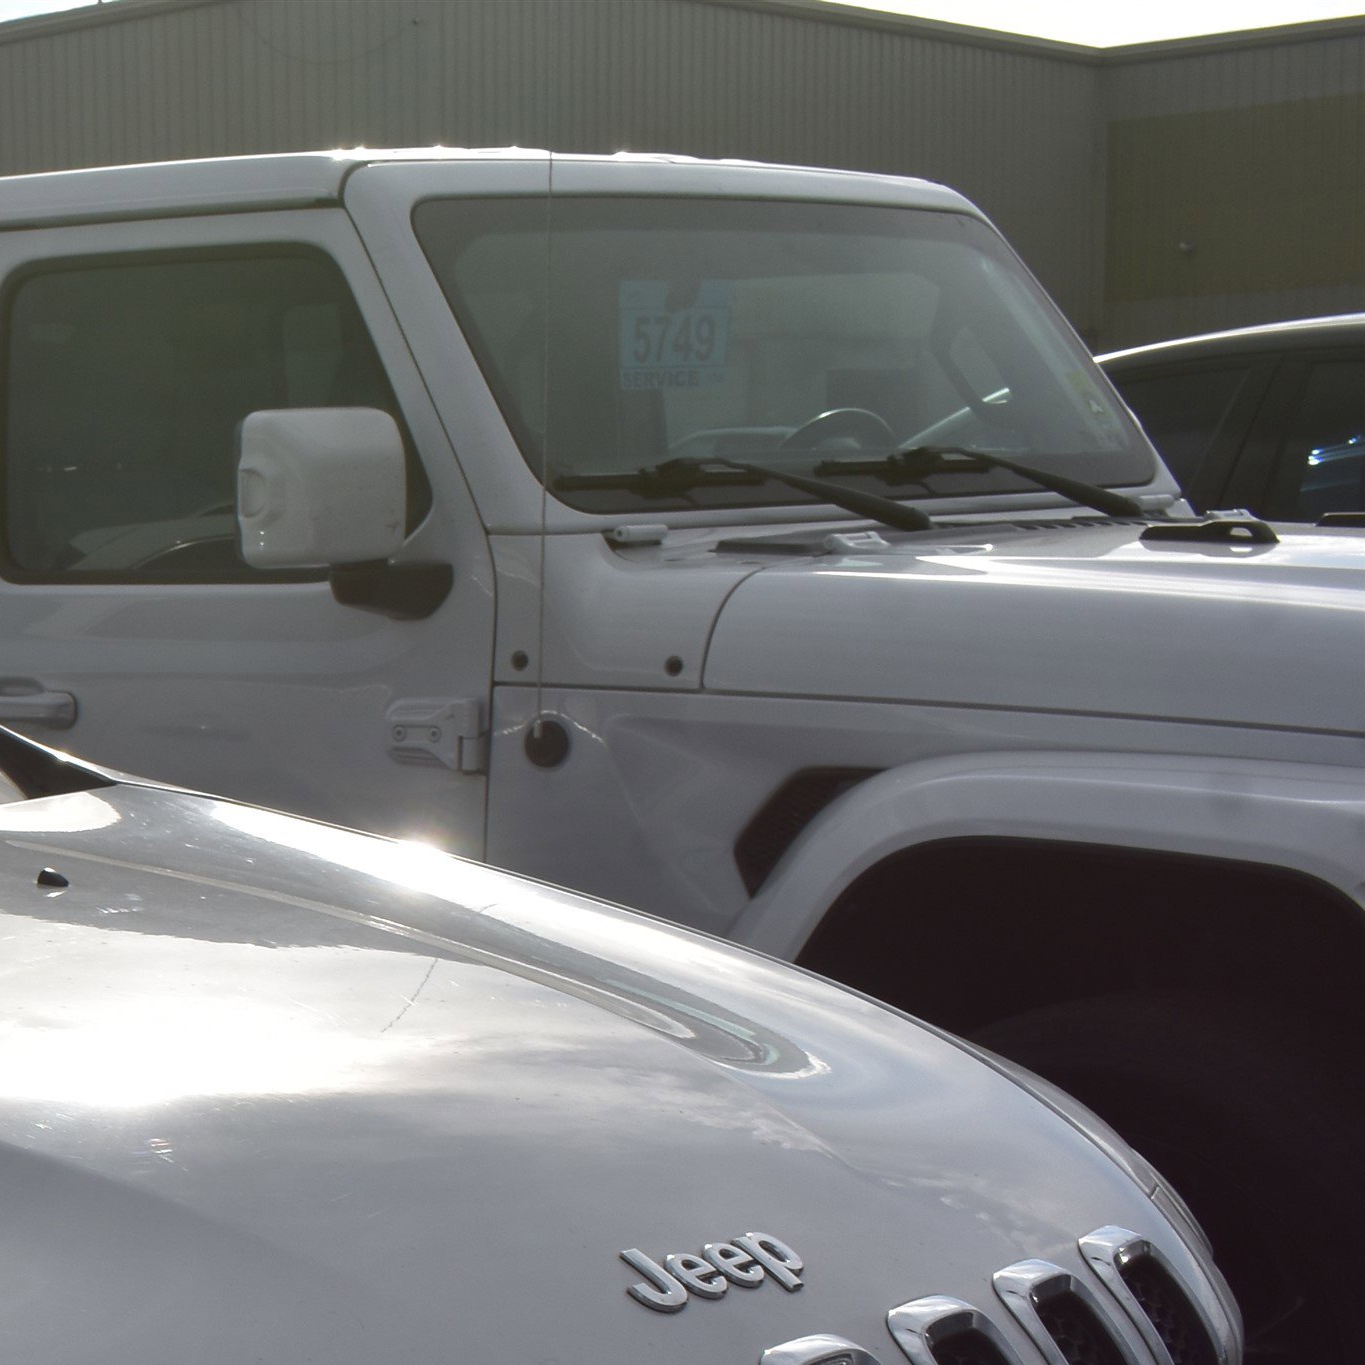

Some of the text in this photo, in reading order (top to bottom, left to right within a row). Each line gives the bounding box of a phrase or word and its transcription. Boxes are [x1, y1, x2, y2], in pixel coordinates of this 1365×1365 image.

[632, 314, 716, 364] 5749
[621, 370, 700, 389] SERVICE
[619, 1231, 804, 1313] Jeep
